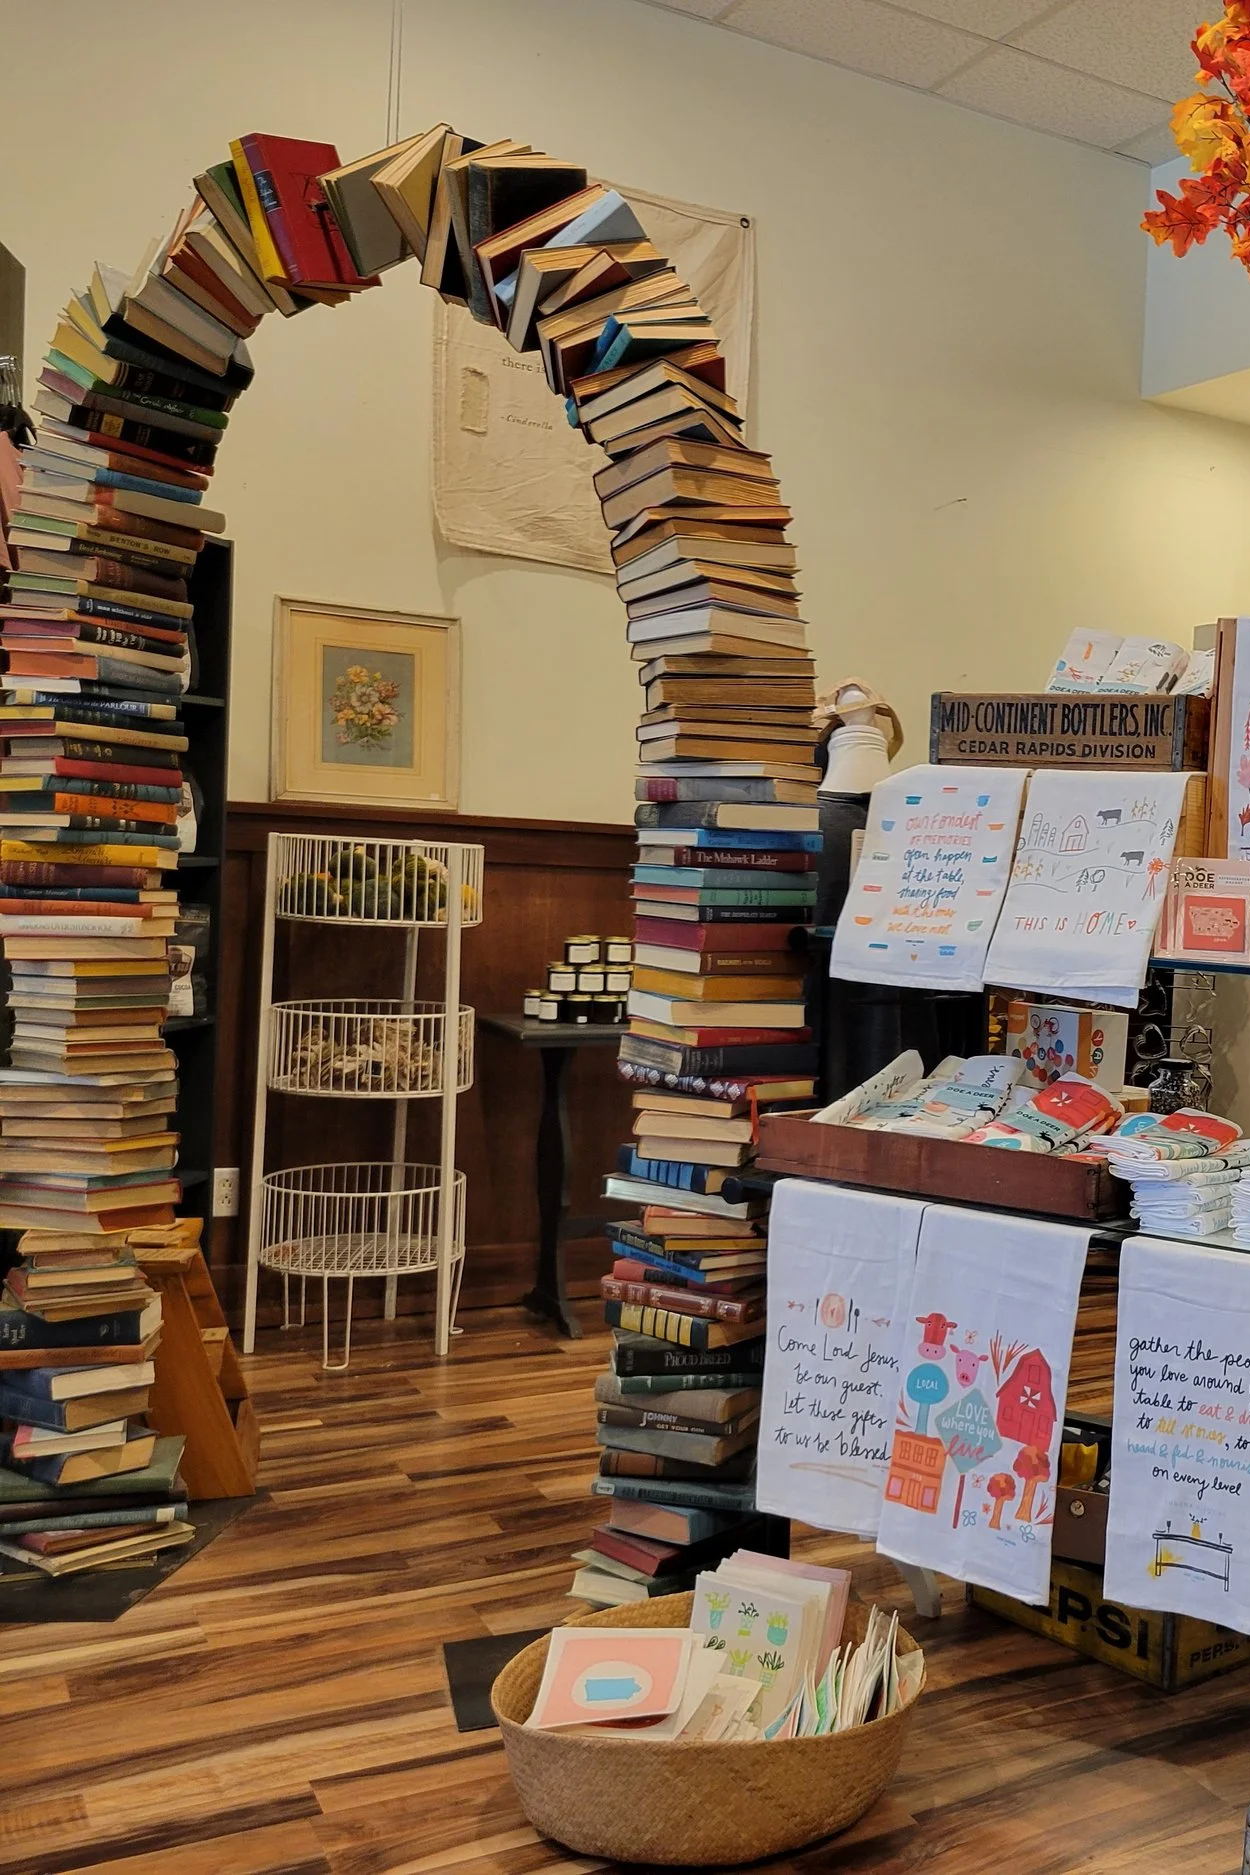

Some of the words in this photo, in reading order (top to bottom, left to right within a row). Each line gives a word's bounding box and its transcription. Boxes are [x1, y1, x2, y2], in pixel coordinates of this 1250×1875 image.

[502, 357, 533, 371] there
[109, 536, 148, 549] BENTON'S
[153, 546, 171, 554] ROW
[941, 702, 1057, 736] MID-CONTINENT
[1060, 703, 1142, 738] BOTTLERS,
[1143, 704, 1173, 737] INC.
[958, 740, 1010, 755] CEDAR
[1015, 742, 1076, 757] RAPIDS
[1081, 743, 1155, 759] DIVISION
[696, 851, 713, 862] The
[714, 852, 749, 864] Mohawk
[751, 854, 778, 865] Ladder
[1185, 872, 1215, 883] DOE
[1014, 916, 1048, 931] THIS
[1055, 917, 1067, 931] IS
[1074, 910, 1127, 936] HOME
[664, 1351, 698, 1367] PROUD
[700, 1352, 731, 1365] BREED
[777, 1325, 816, 1354] Come
[823, 1333, 858, 1361] Lord
[860, 1344, 901, 1373] Jesus,
[1129, 1337, 1181, 1360] gather
[1184, 1340, 1218, 1361] the
[795, 1363, 812, 1384] be
[814, 1375, 837, 1387] our
[840, 1379, 884, 1405] guest.
[916, 1379, 939, 1390] LOCAL
[1129, 1363, 1156, 1390] you
[1160, 1364, 1189, 1383] love
[1193, 1374, 1245, 1395] around
[640, 1412, 678, 1427] JOHNNY
[784, 1391, 805, 1415] Let
[810, 1399, 846, 1420] these
[851, 1406, 888, 1436] gifts
[956, 1401, 989, 1420] LOVE
[1133, 1391, 1173, 1410] table
[1177, 1395, 1198, 1412] to
[1198, 1402, 1223, 1421] eat
[1223, 1405, 1234, 1422] &
[774, 1426, 793, 1445] to
[796, 1433, 813, 1449] us
[815, 1431, 830, 1452] be
[941, 1416, 974, 1433] where
[975, 1426, 994, 1447] you
[944, 1434, 994, 1463] live
[1055, 1584, 1149, 1660] PSI
